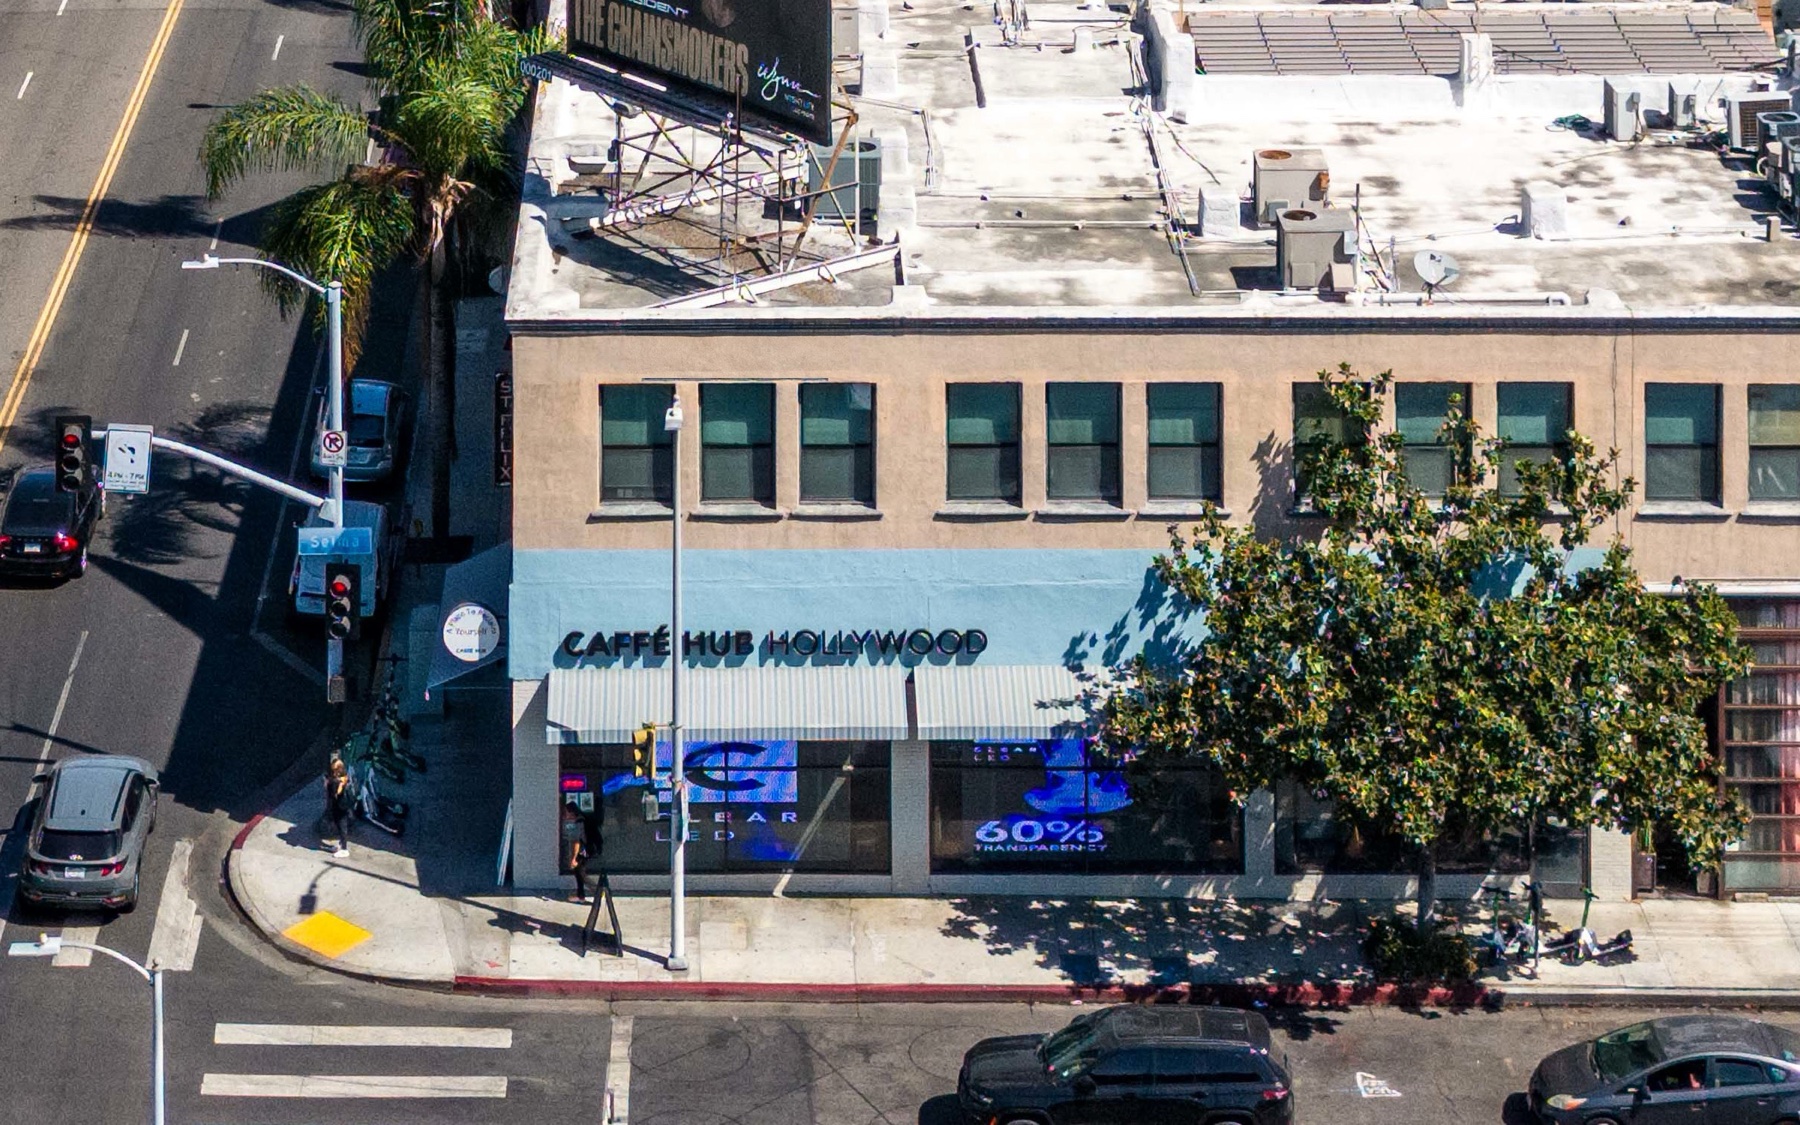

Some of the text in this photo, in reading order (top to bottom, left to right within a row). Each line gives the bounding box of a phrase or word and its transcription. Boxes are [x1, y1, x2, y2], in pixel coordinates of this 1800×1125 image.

[574, 0, 749, 97] THE CHAINSMOKERS
[564, 624, 988, 657] CAFFÉ HUB HOLLYWOOD
[975, 819, 1104, 843] 60%
